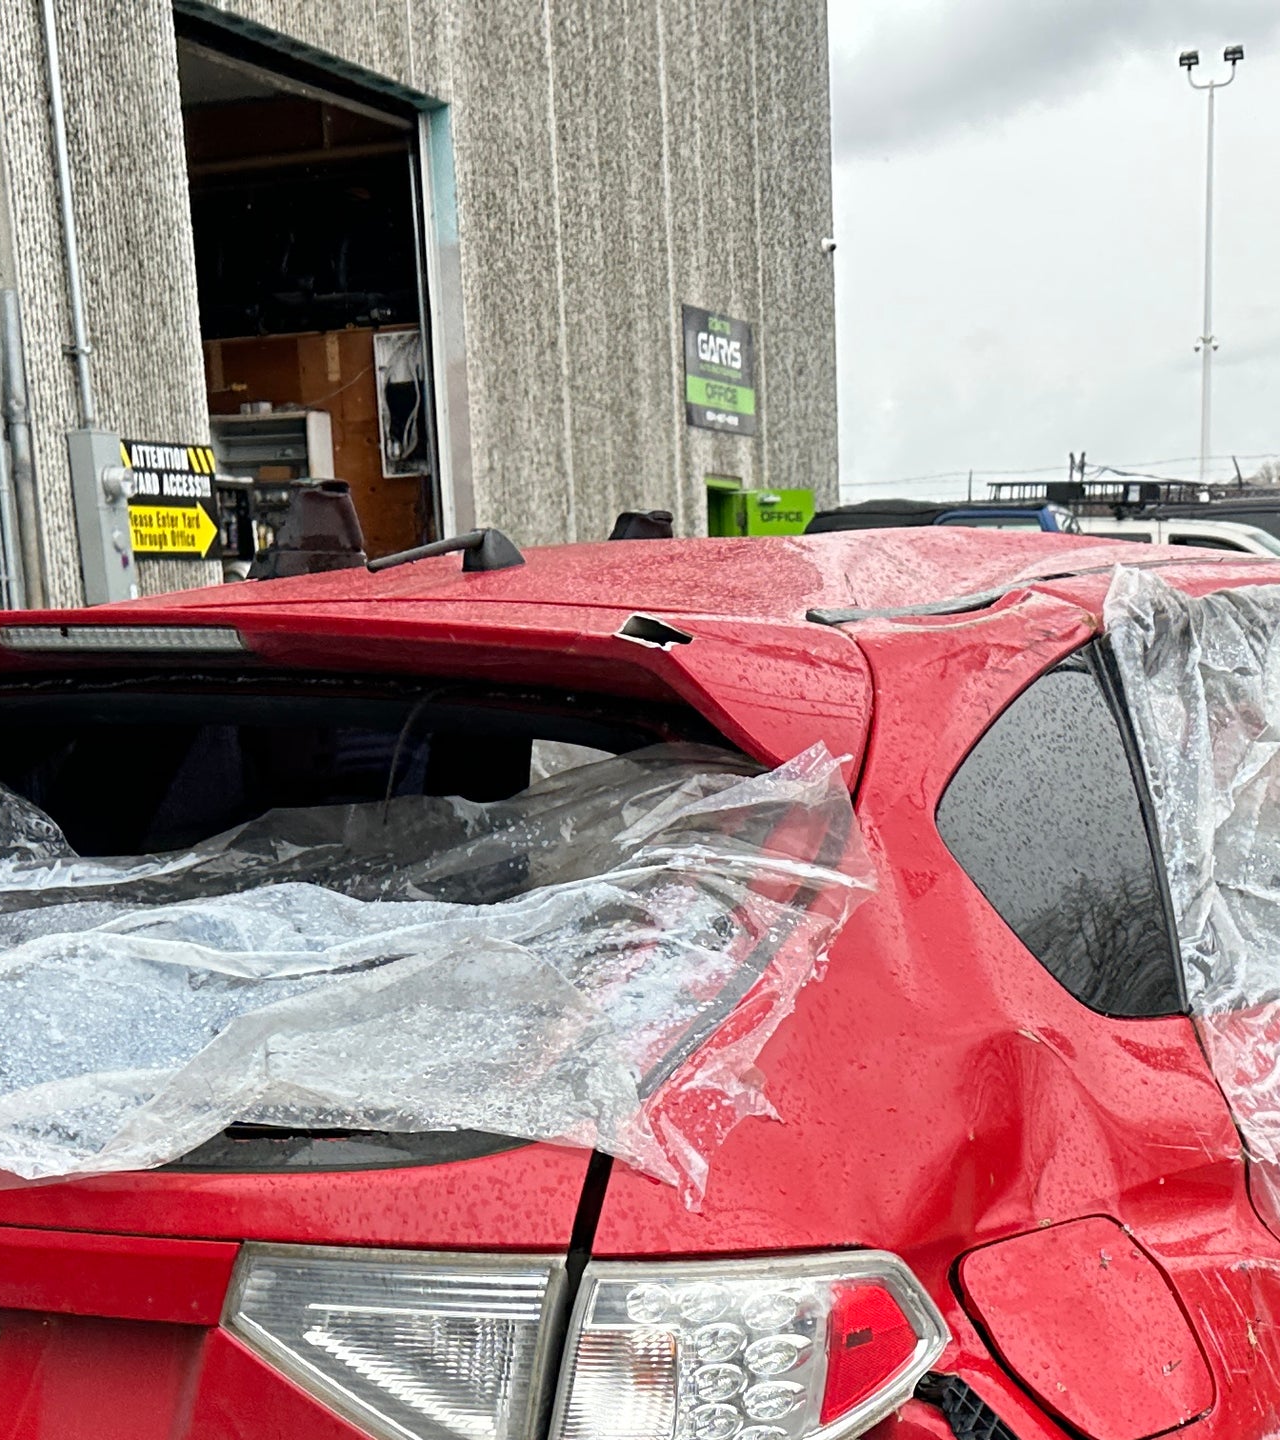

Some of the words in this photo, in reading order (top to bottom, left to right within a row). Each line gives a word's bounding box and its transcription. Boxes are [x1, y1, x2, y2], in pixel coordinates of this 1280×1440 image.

[131, 444, 189, 471] ATTENTION
[129, 511, 153, 528] lease
[156, 511, 178, 529] Enter
[182, 512, 200, 529] Yard
[760, 509, 803, 523] OFFICE
[134, 529, 168, 550] Through
[170, 530, 195, 547] Office
